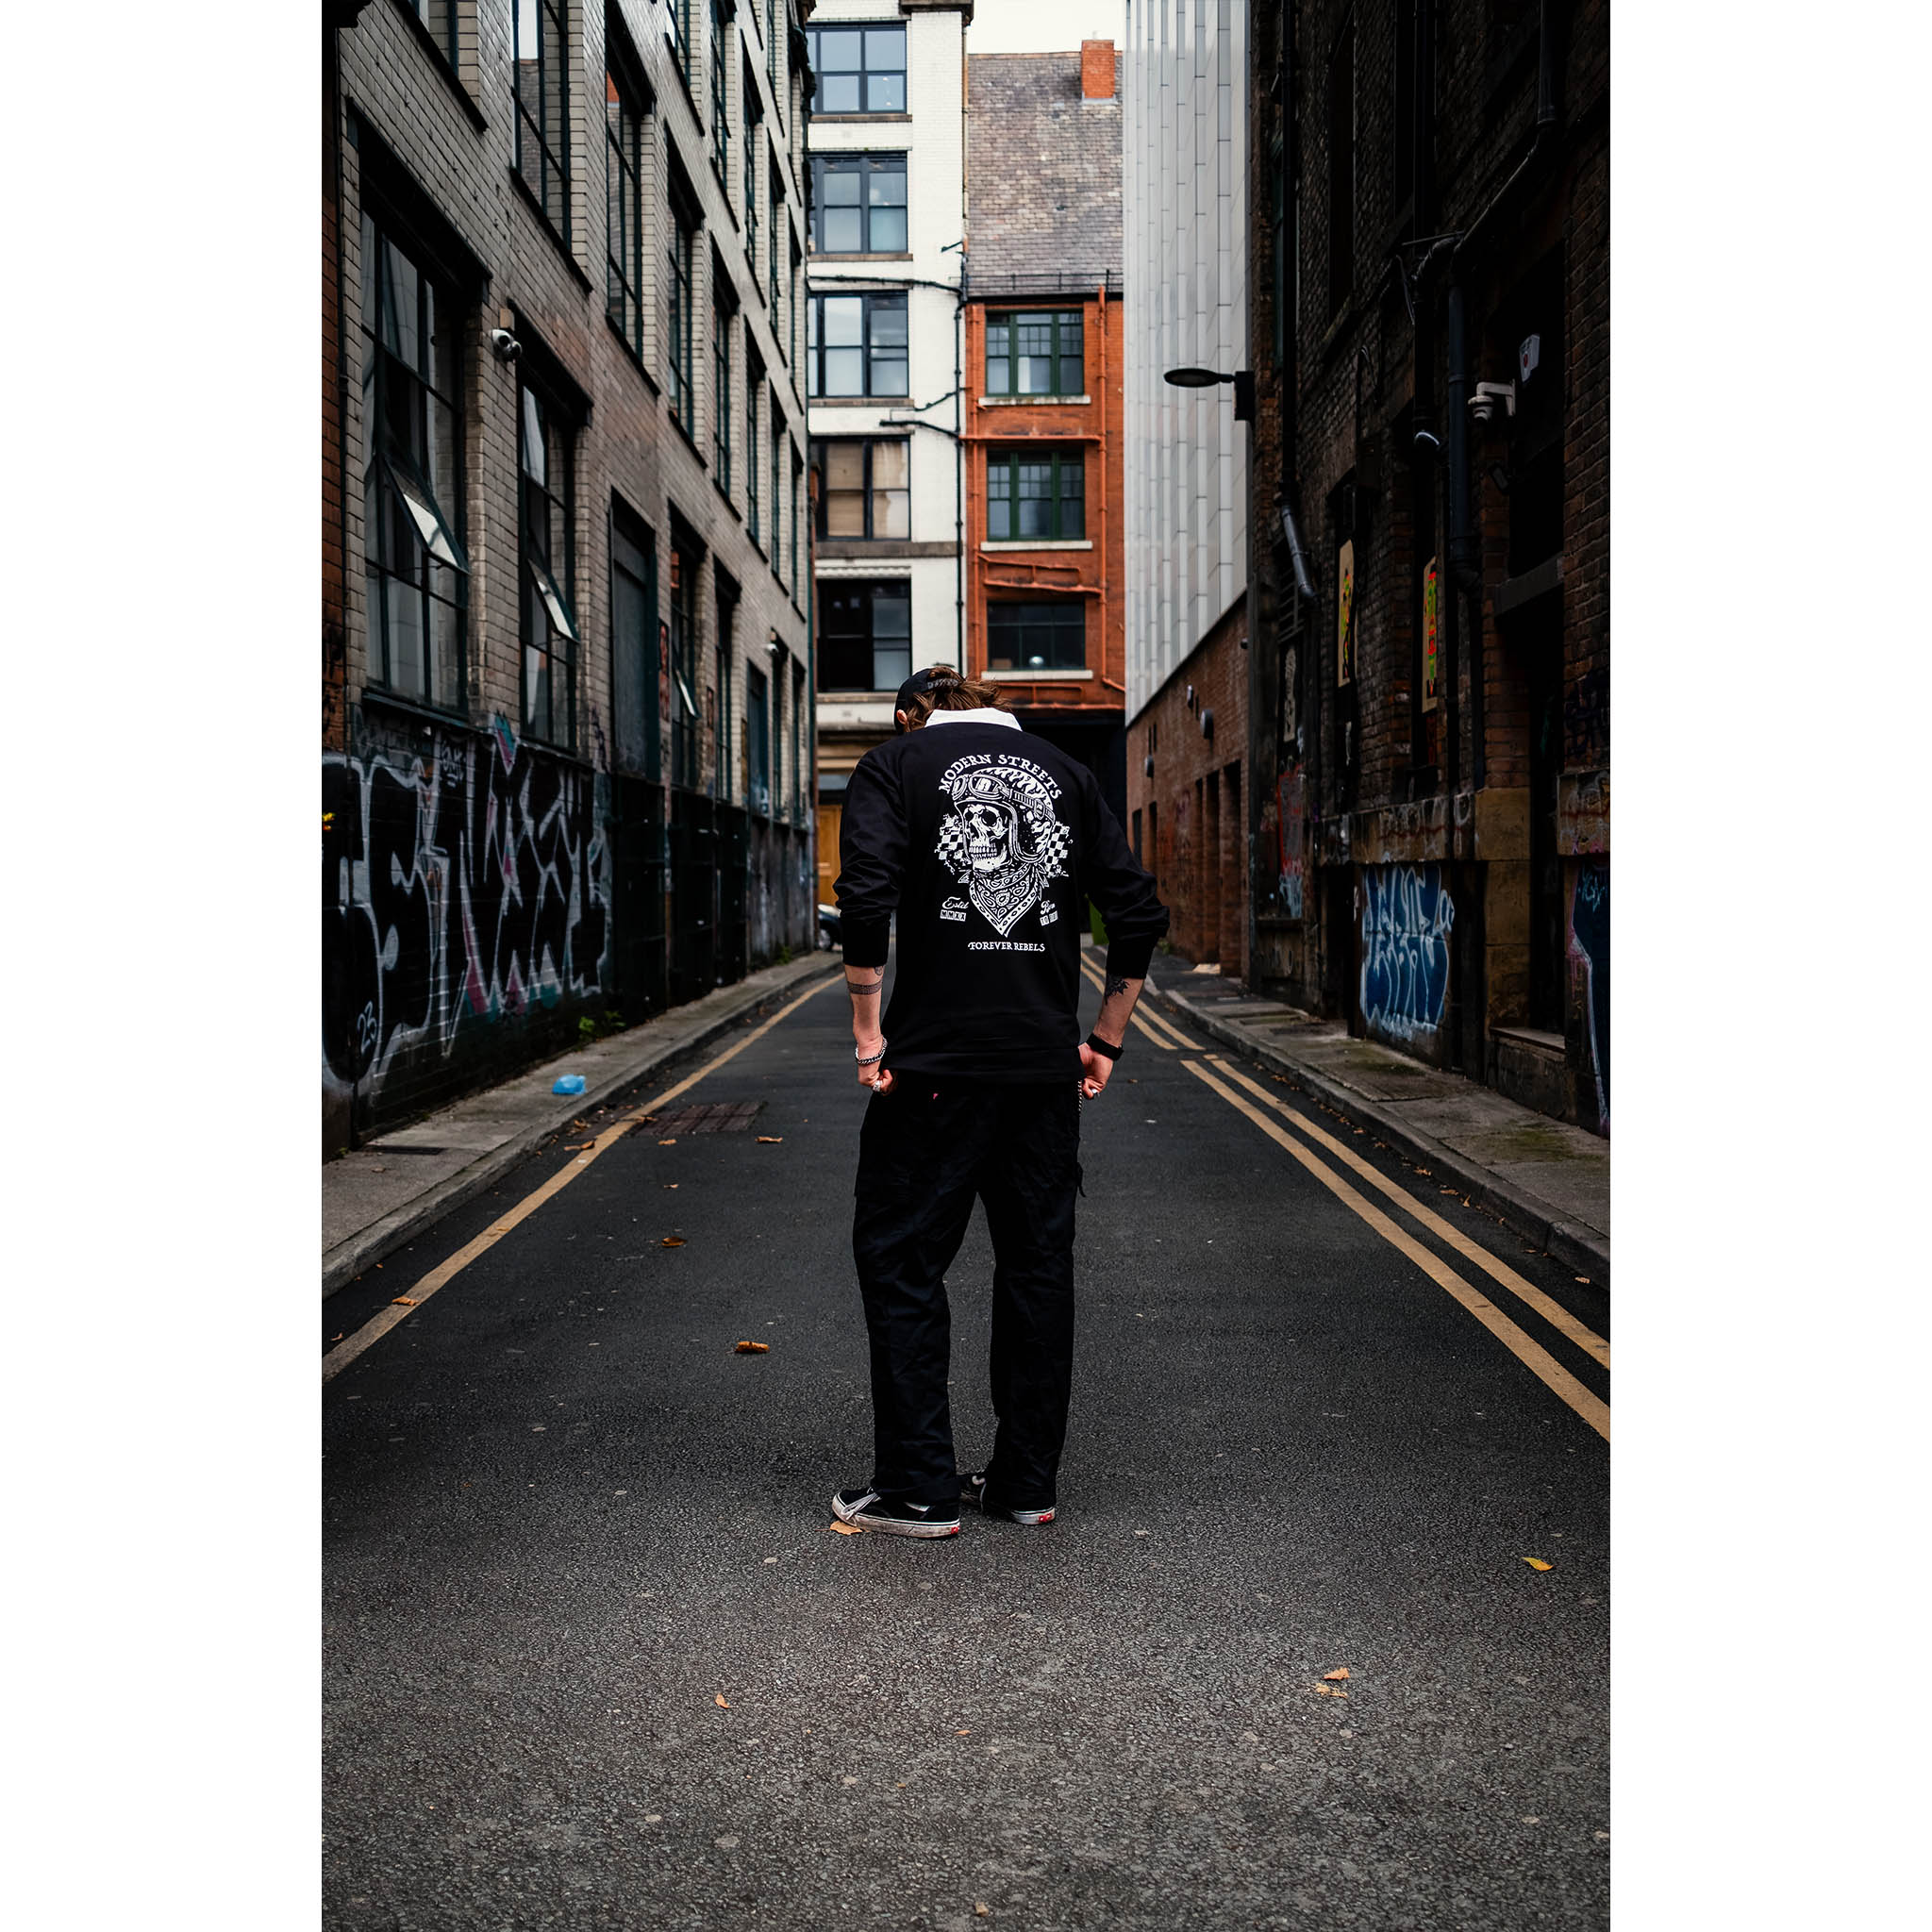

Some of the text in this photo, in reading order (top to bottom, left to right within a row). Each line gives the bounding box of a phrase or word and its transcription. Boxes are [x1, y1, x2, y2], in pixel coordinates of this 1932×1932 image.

[939, 755, 1062, 799] MODERN STREETS
[968, 941, 1045, 952] FOREVER REBELS
